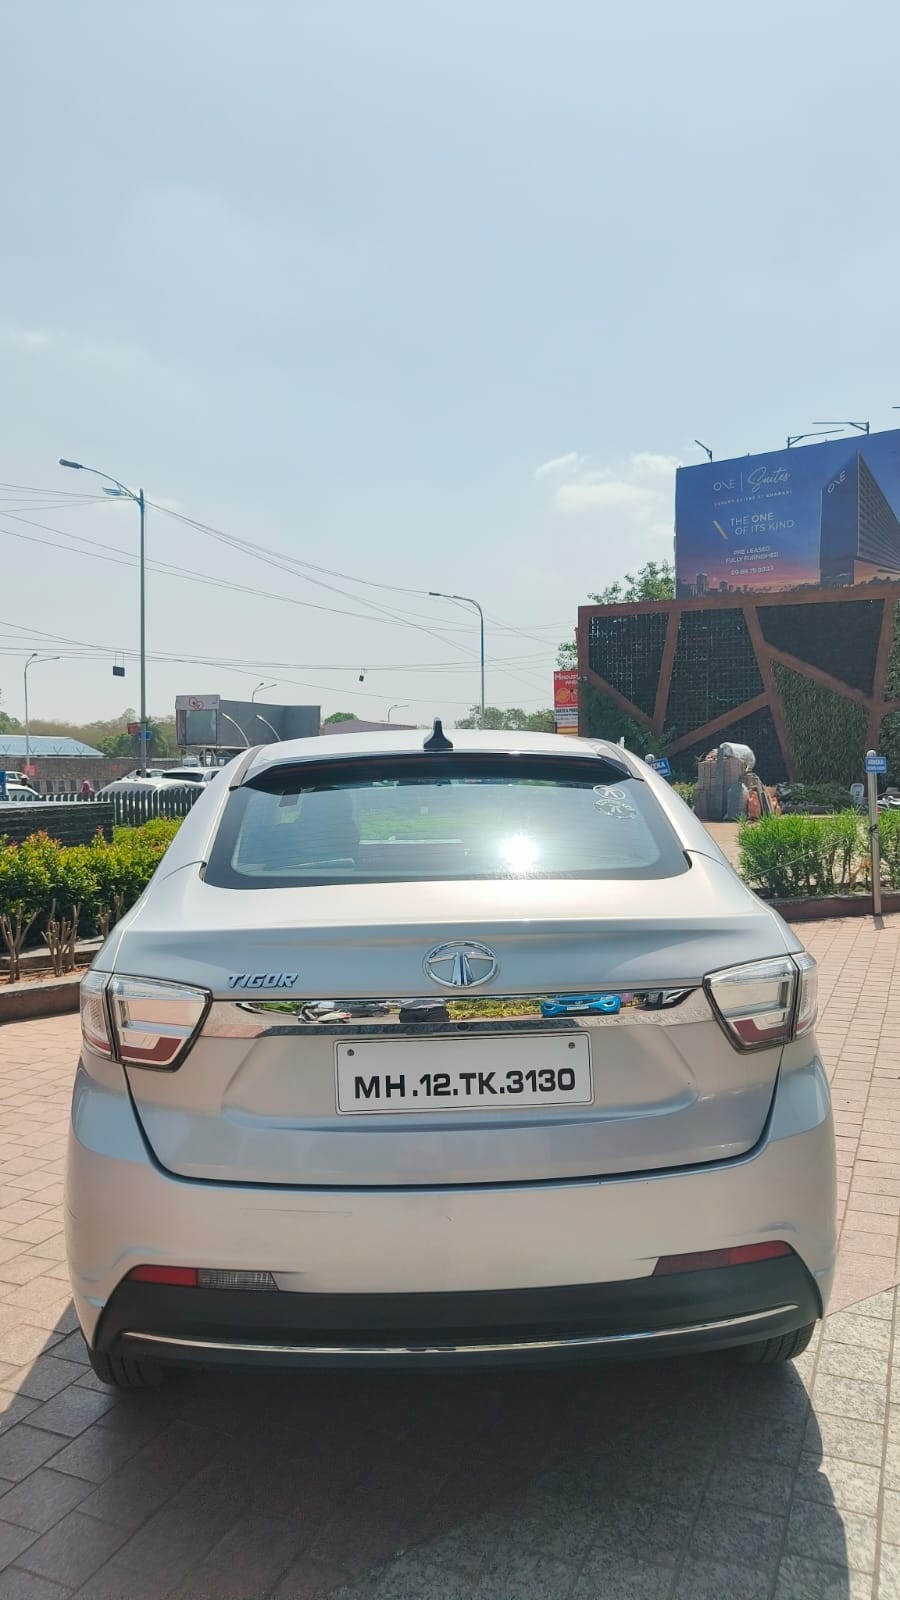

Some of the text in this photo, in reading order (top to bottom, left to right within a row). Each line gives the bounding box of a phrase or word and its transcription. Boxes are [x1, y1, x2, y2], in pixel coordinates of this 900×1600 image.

[713, 466, 791, 493] ONE Suites
[730, 512, 775, 527] THE ONE
[735, 519, 795, 535] OF ITS KIND
[227, 972, 298, 988] TIGOR
[354, 1067, 576, 1099] MH.12.TK.3130
